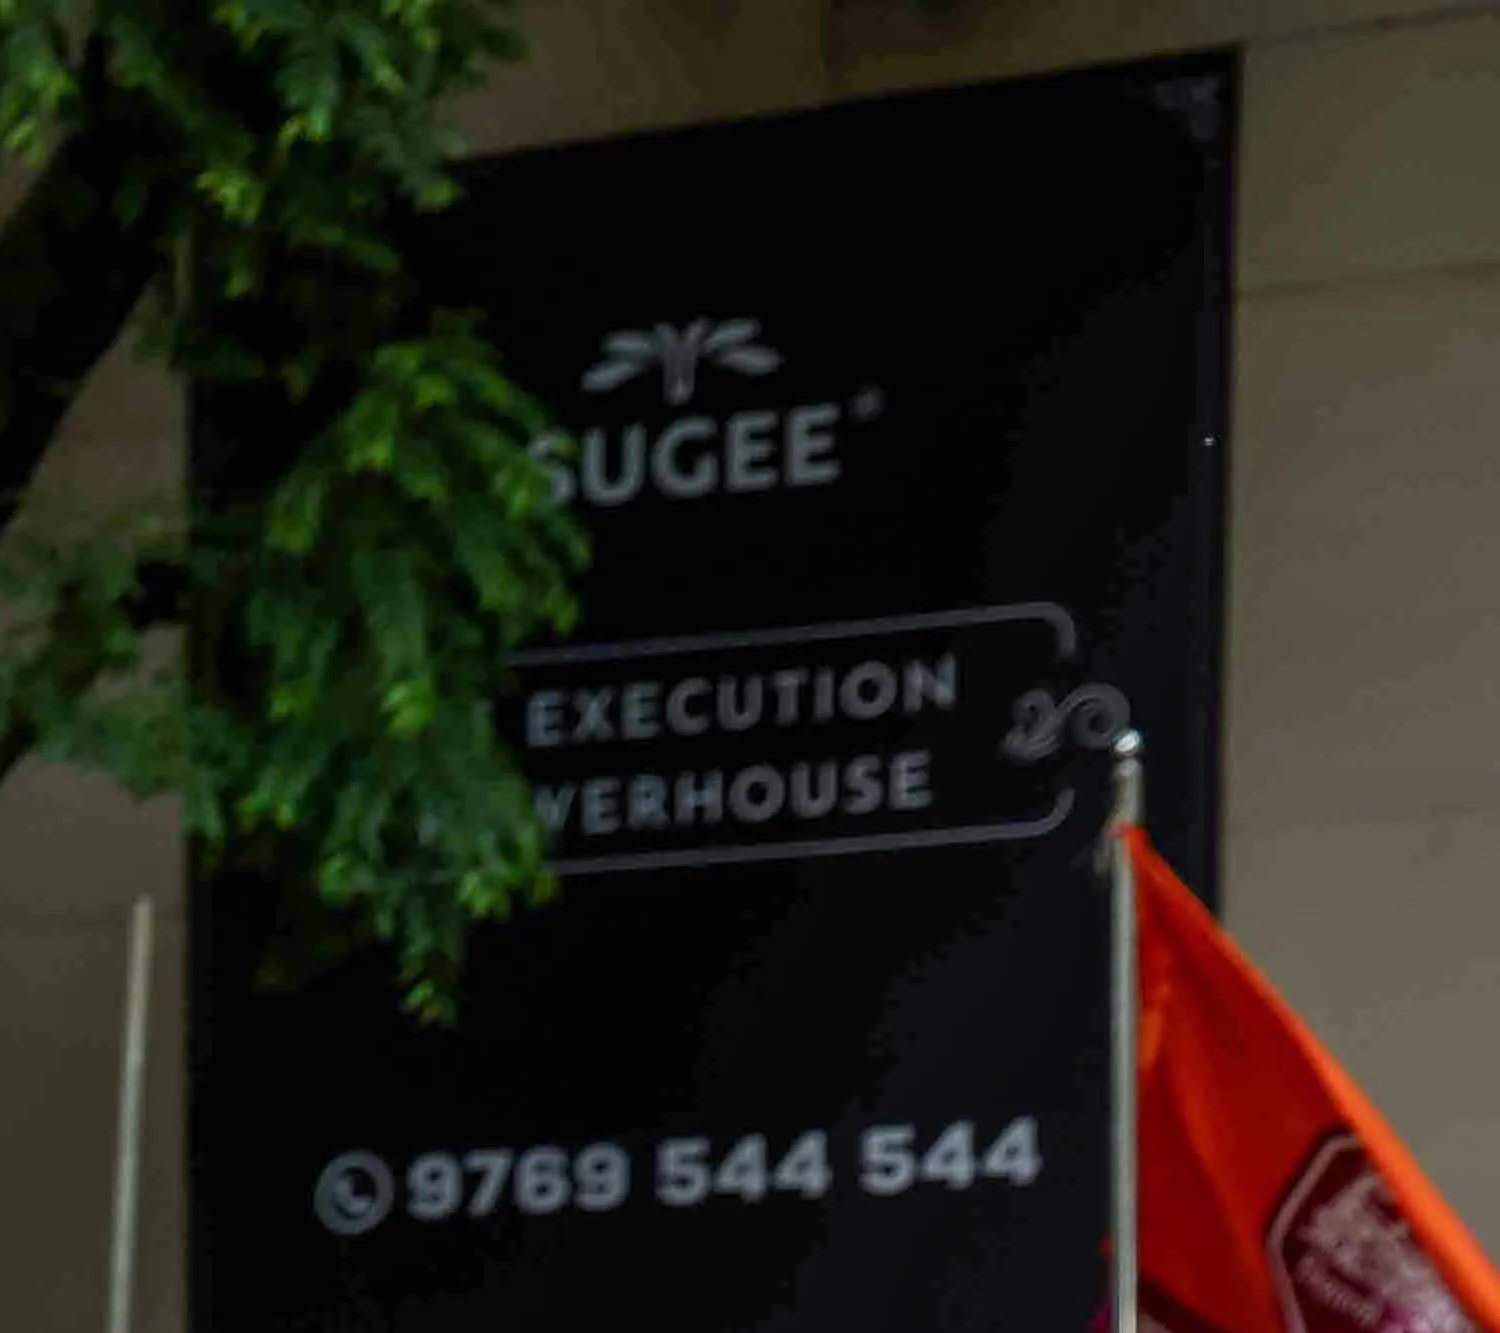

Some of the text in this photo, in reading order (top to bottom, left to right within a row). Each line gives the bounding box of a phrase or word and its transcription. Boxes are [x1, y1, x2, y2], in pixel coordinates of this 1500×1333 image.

[529, 403, 842, 507] SUGEE
[525, 652, 959, 748] EXECUTION
[532, 751, 935, 837] WERHOUSE
[407, 1116, 1042, 1221] 9769 544 544
